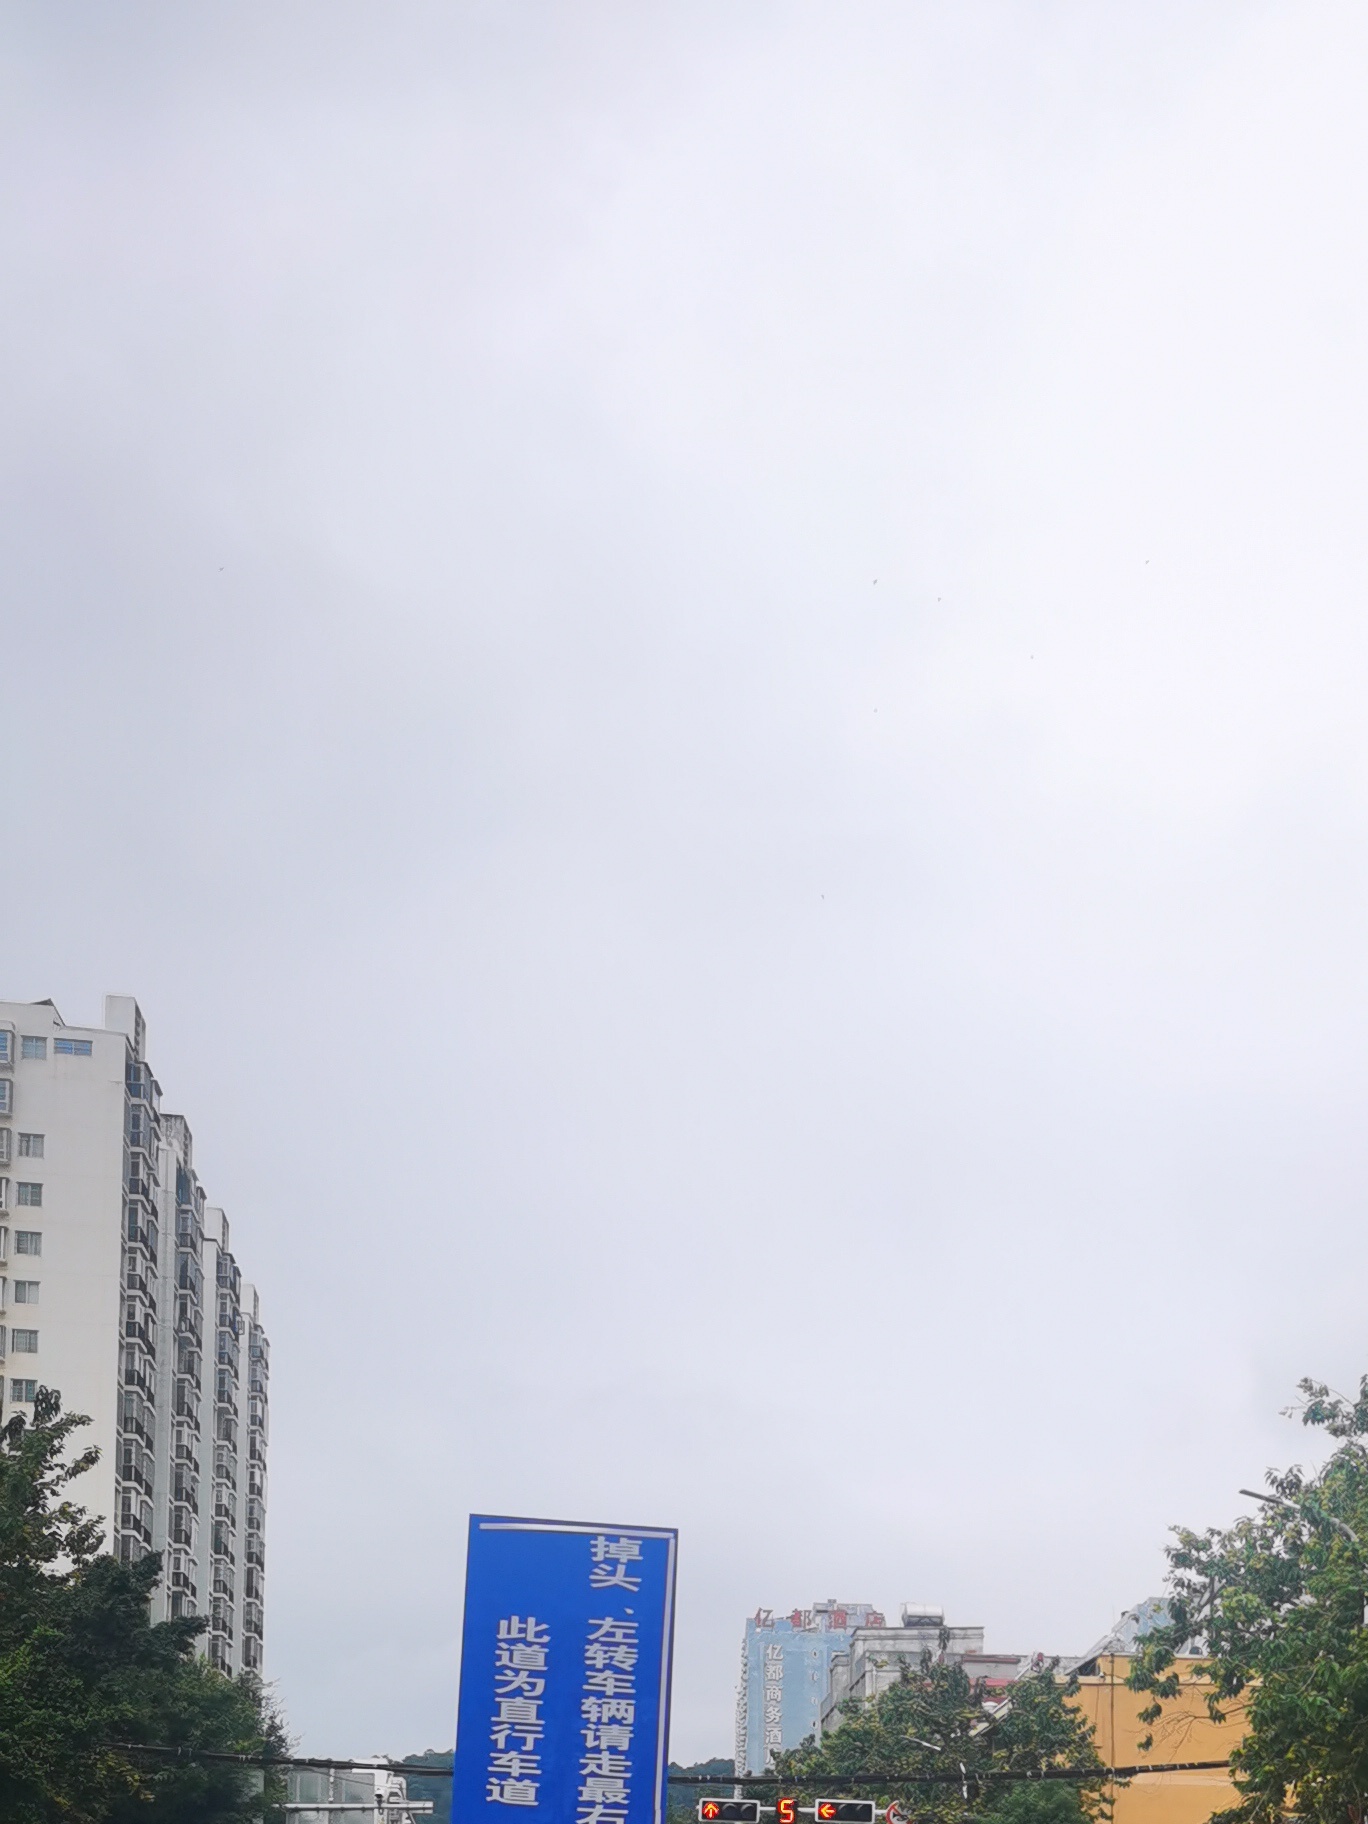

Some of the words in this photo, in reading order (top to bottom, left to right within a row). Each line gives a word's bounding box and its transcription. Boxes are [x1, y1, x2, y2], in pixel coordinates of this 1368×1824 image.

[485, 1615, 551, 1807] 此道为直行车道
[778, 1797, 795, 1824] 5
